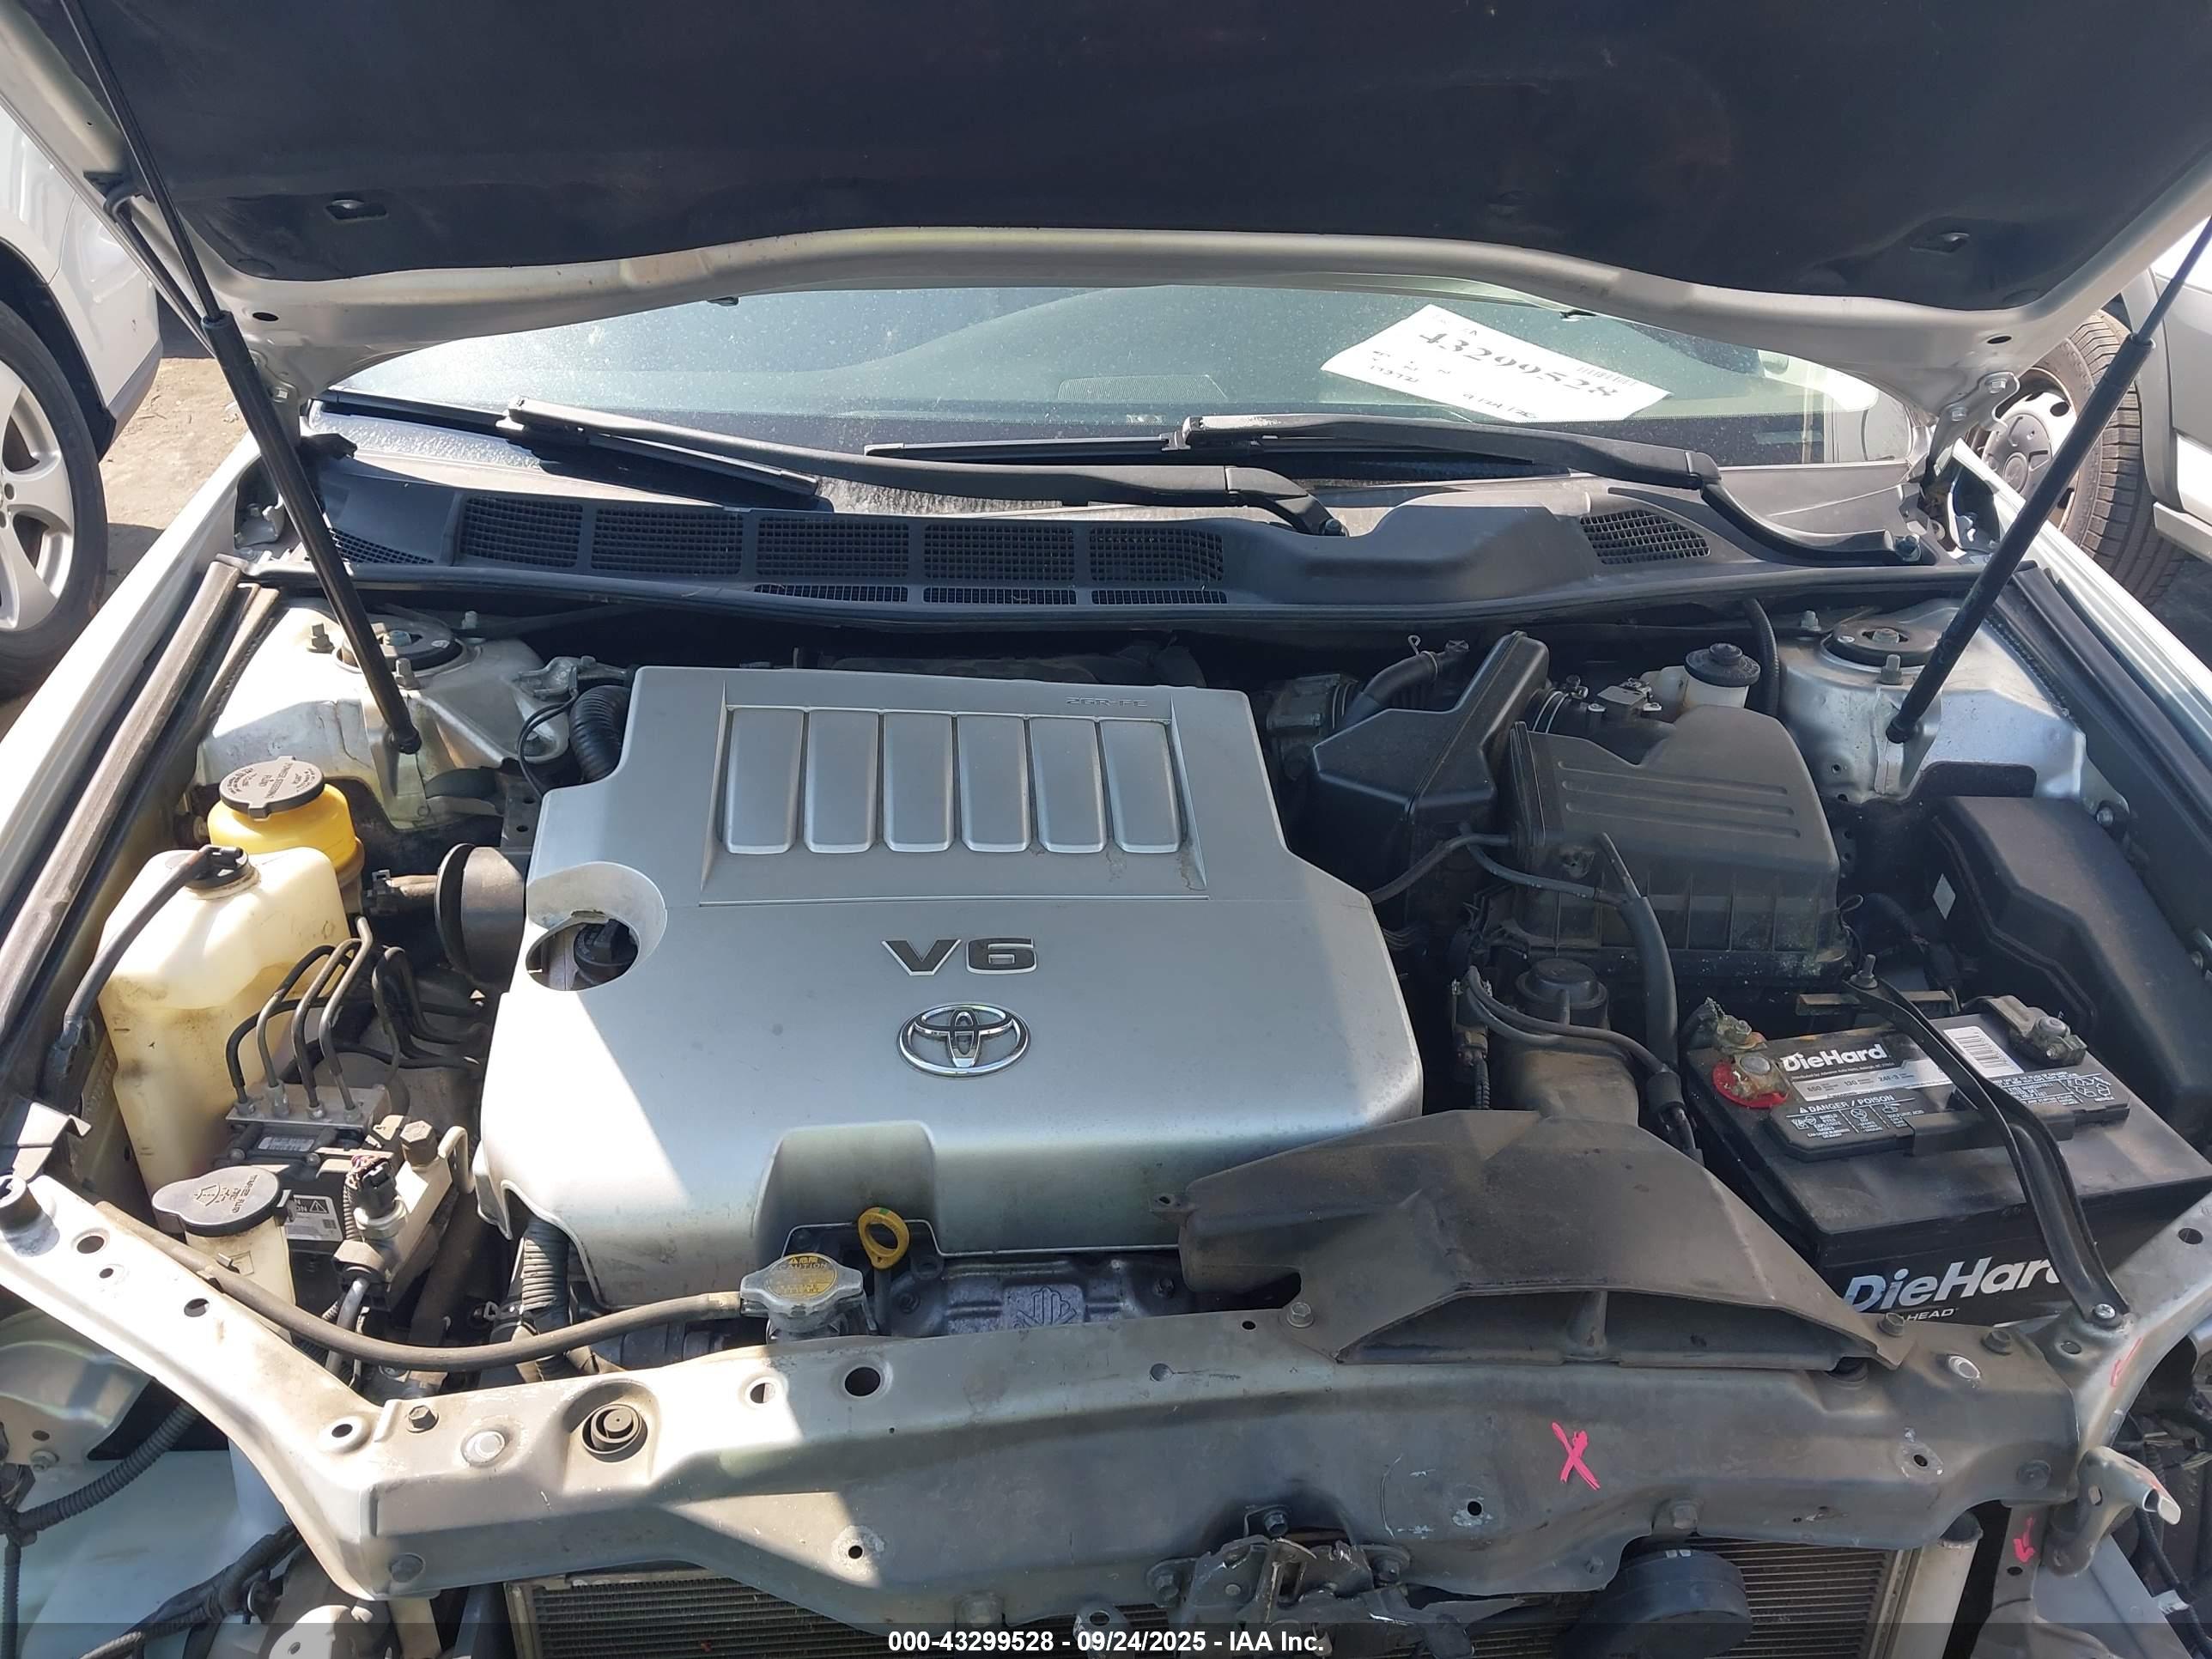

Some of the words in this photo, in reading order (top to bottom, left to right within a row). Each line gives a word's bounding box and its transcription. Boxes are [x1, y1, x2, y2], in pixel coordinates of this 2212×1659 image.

[1419, 332, 1622, 398] 43299528
[881, 938, 1036, 975] V6
[1779, 1044, 1887, 1072] DieHard
[1808, 1101, 1850, 1113] DANGER
[1858, 1095, 1895, 1106] POISON
